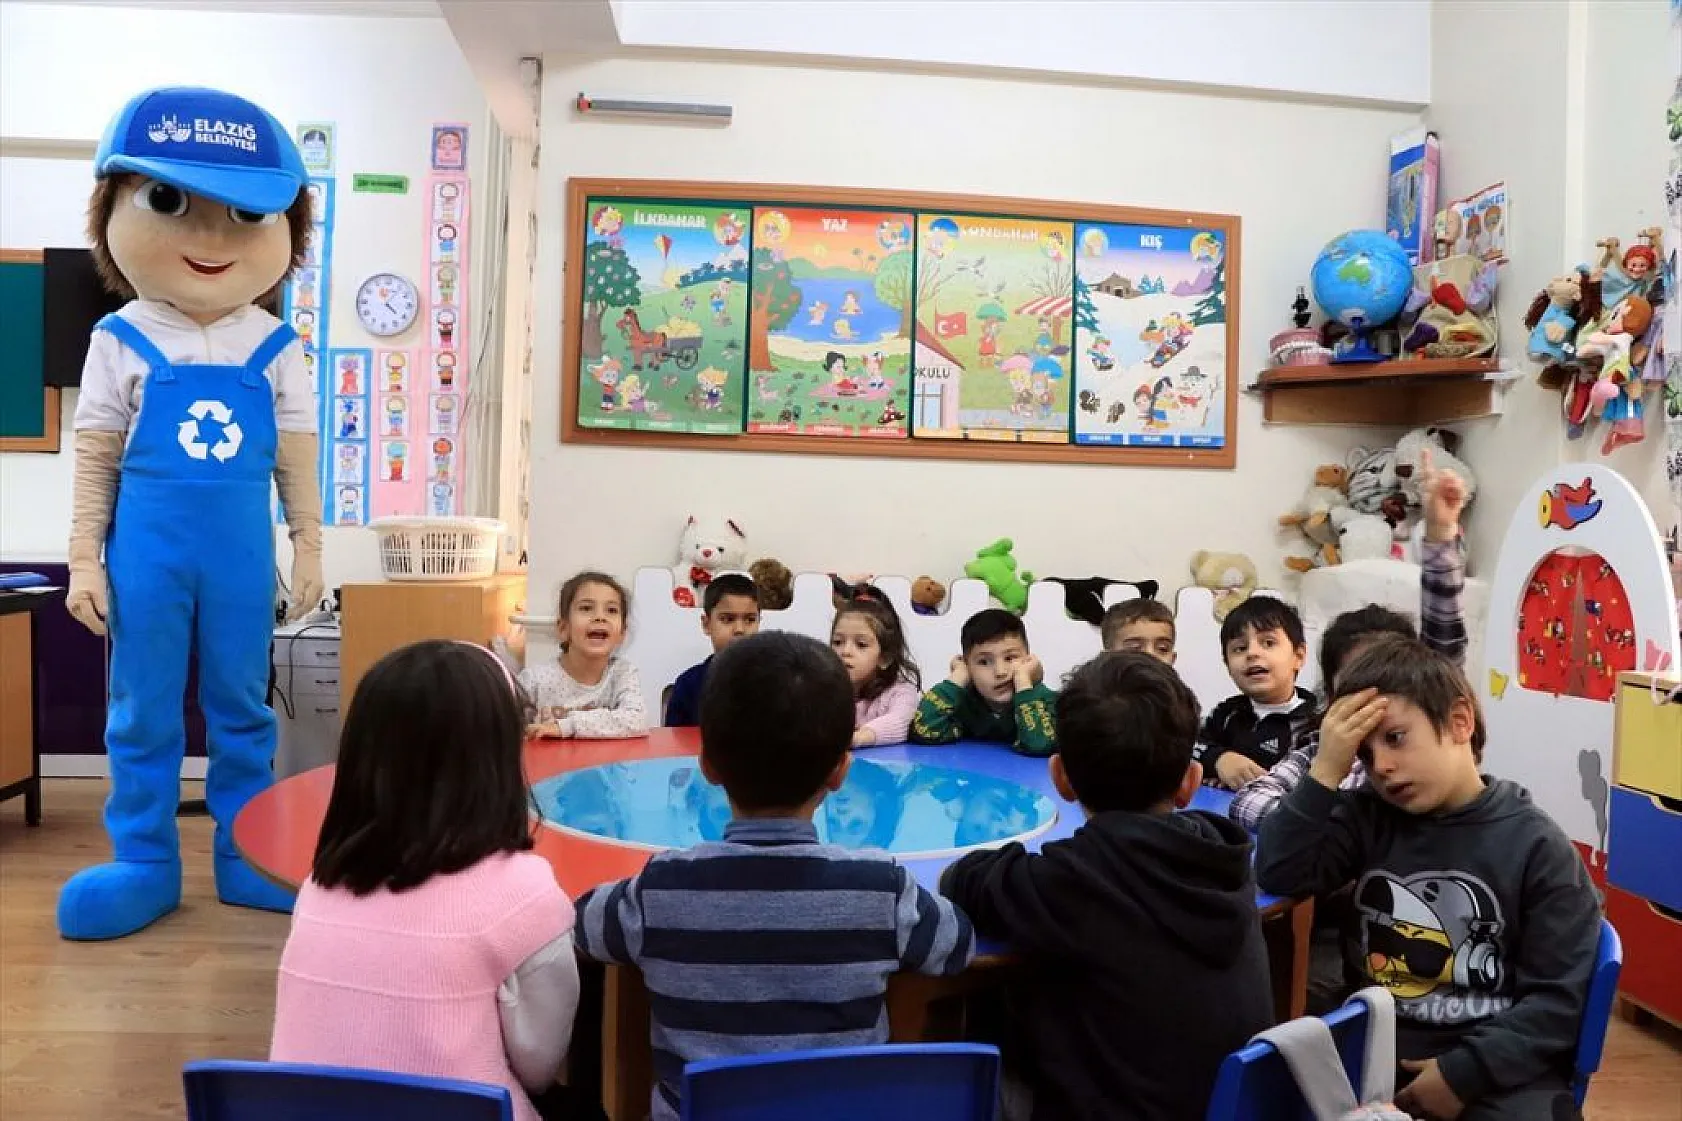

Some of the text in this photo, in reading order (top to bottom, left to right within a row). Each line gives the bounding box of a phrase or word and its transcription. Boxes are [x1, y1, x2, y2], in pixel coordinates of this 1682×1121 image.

[194, 118, 256, 140] ELAZIĞ
[823, 218, 848, 233] YAZ
[1140, 234, 1163, 251] KIŞ
